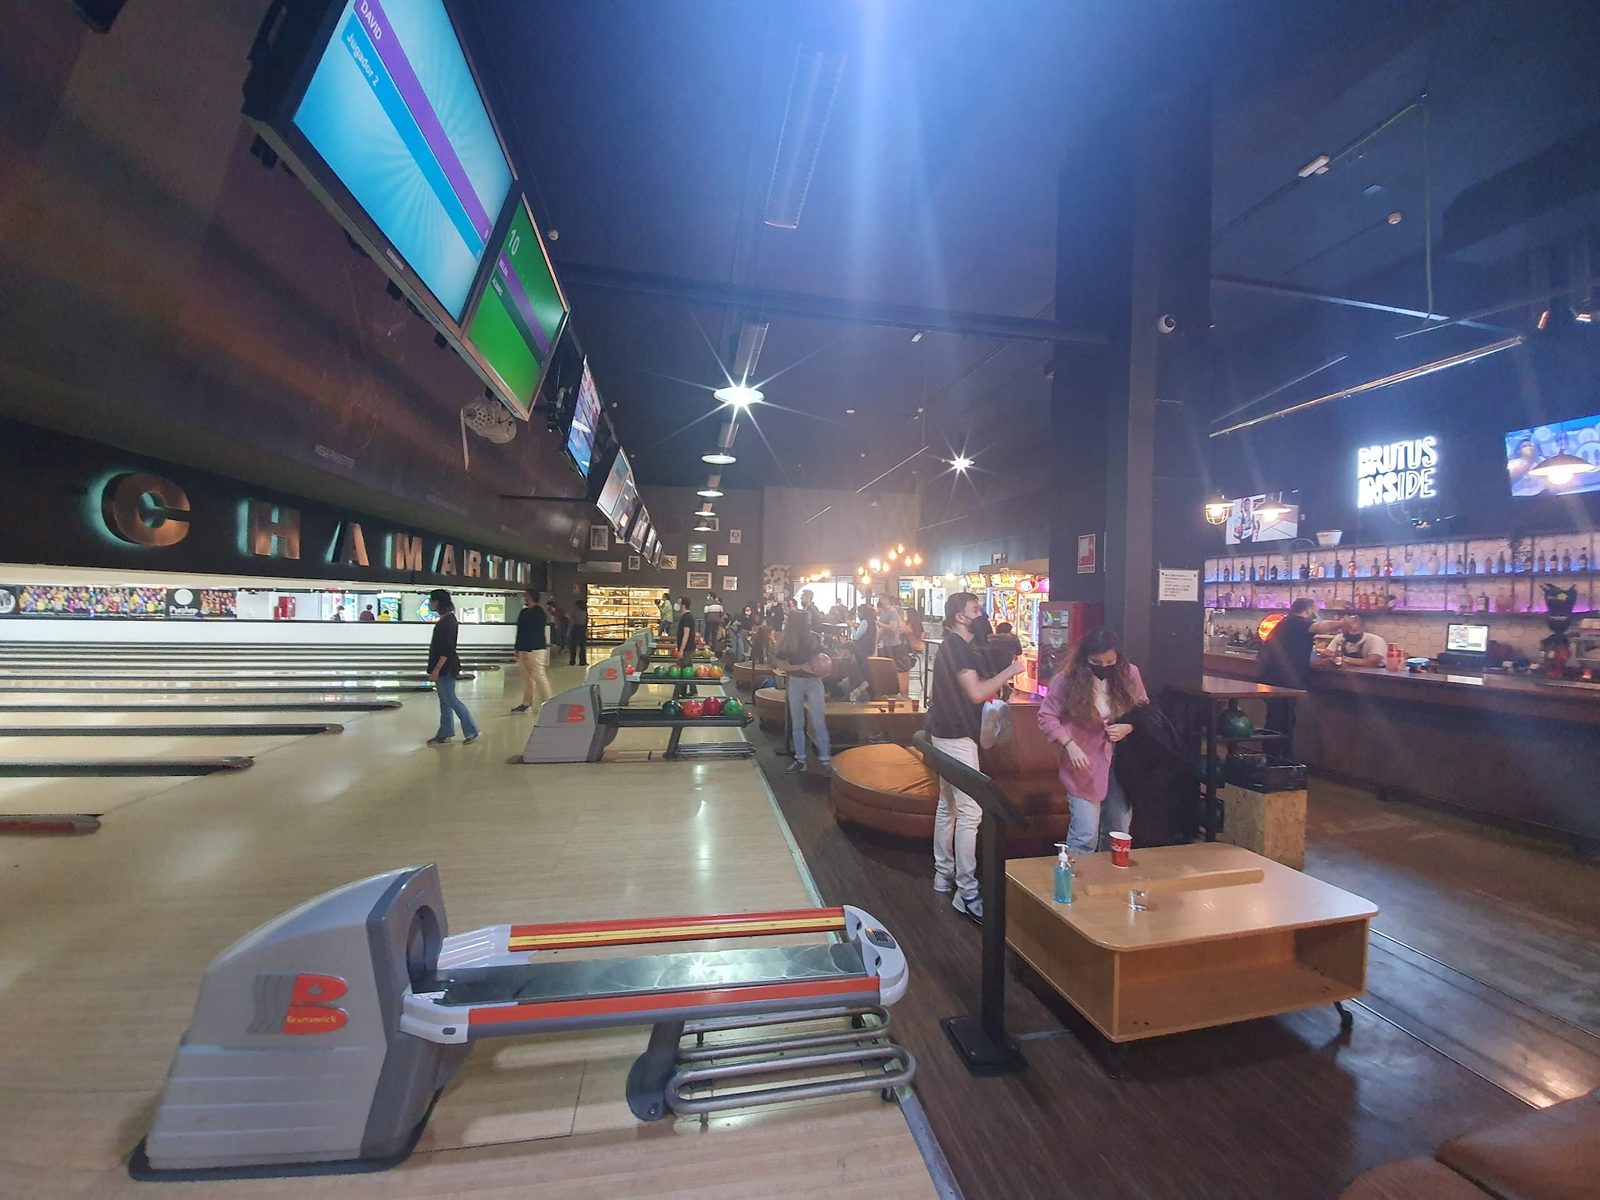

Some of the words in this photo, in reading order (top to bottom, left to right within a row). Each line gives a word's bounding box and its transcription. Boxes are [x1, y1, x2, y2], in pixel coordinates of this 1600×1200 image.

[361, 0, 382, 40] DAVID
[346, 33, 374, 77] Jugador
[372, 75, 379, 87] 2
[508, 229, 520, 256] 10
[1358, 436, 1437, 479] BRUTUS
[1358, 468, 1437, 508] INSIDE
[100, 472, 532, 584] CHAMARTIN
